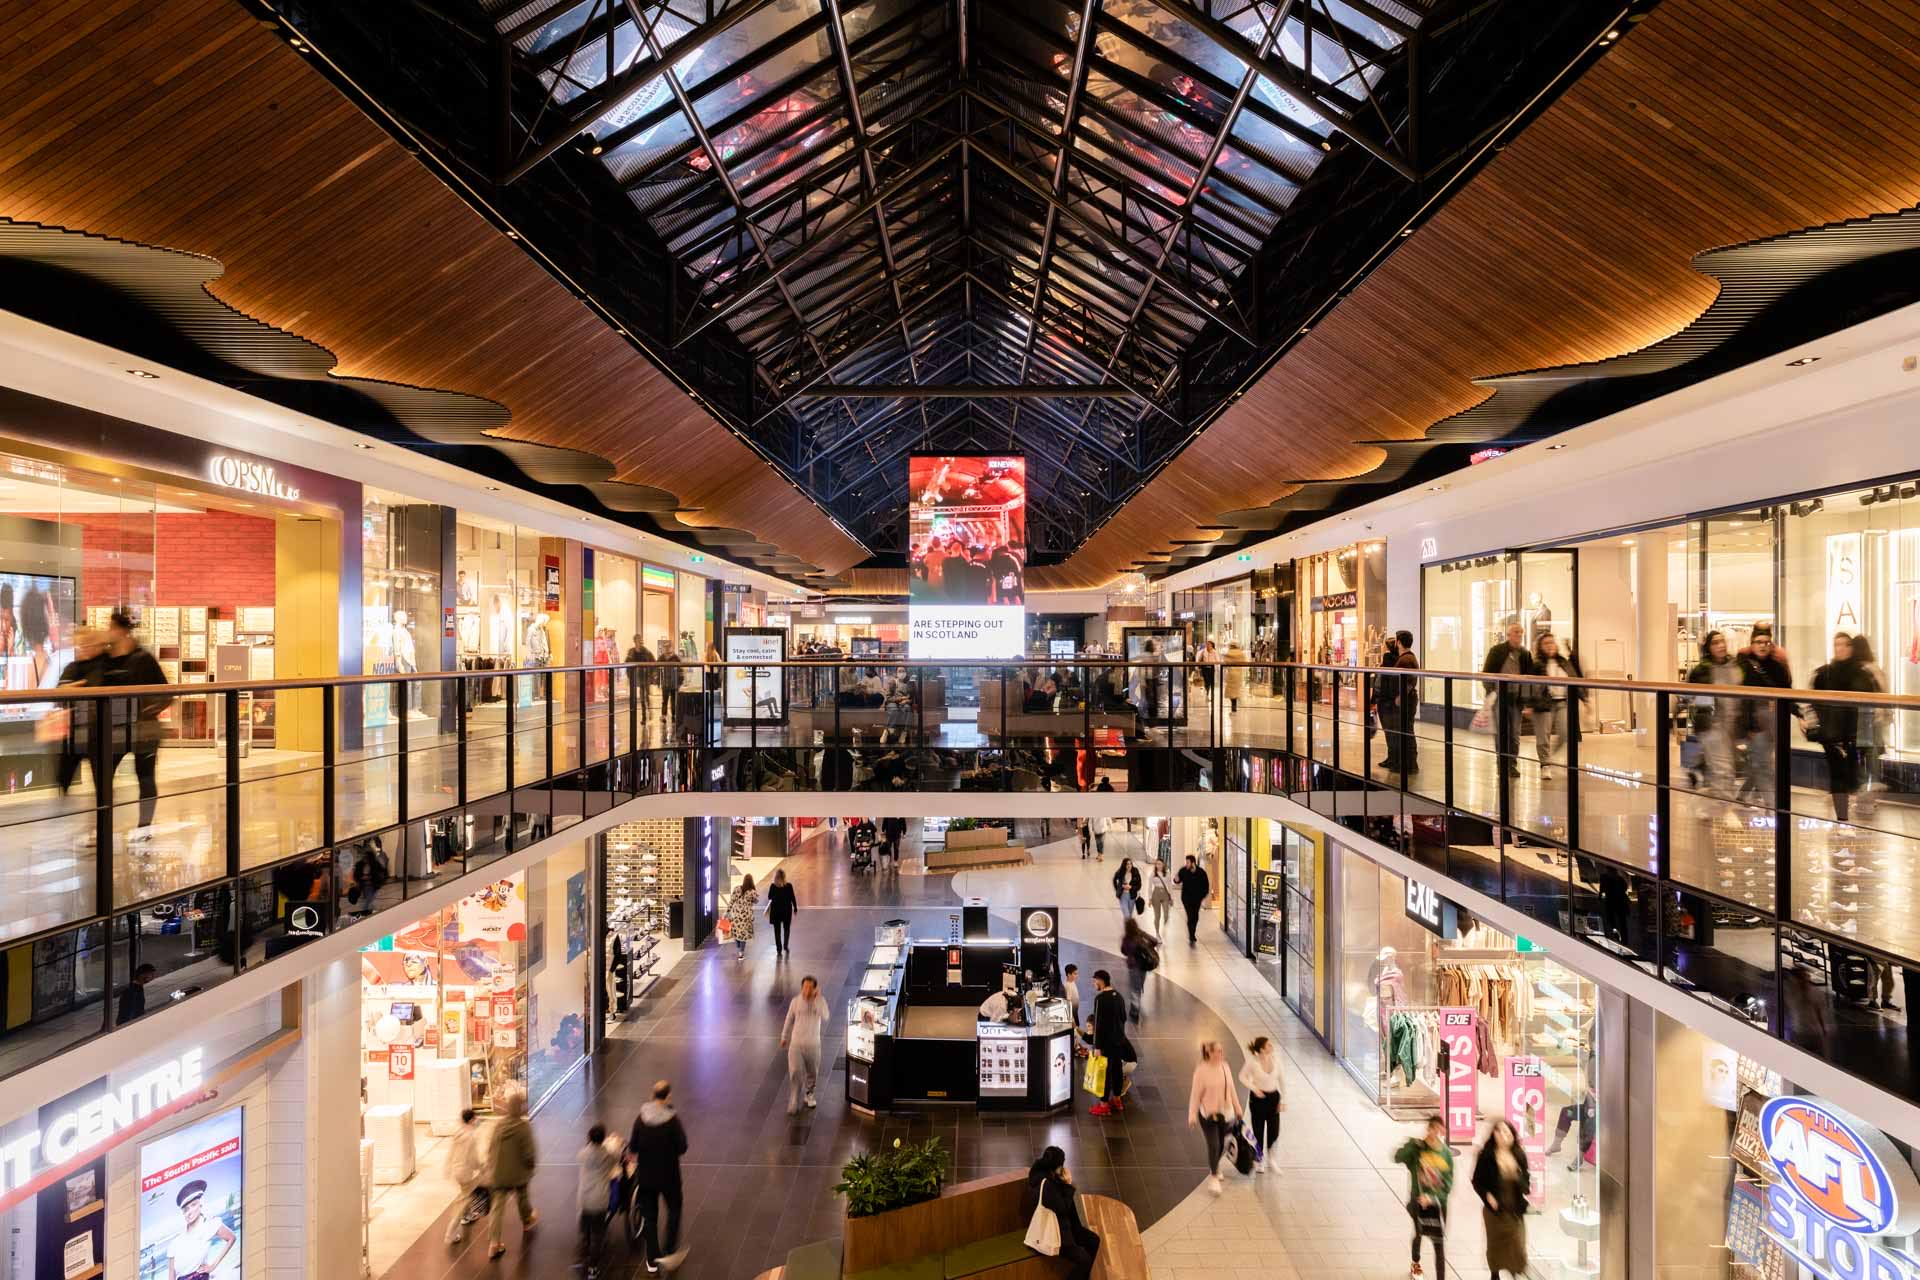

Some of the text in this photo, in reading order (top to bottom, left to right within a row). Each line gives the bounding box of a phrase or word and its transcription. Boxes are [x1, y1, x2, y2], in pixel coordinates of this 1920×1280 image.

[209, 456, 280, 497] OPSM
[913, 620, 1004, 629] ARE STEPPING OUT
[913, 630, 978, 639] IN SCOTLAND
[1407, 877, 1439, 926] EXIE
[497, 1006, 510, 1017] 10
[1446, 1014, 1471, 1025] EXIE
[395, 1055, 408, 1066] 10
[42, 1047, 204, 1166] CENTRE
[143, 1141, 238, 1189] The South Pacific sale
[1769, 1112, 1885, 1233] AFL
